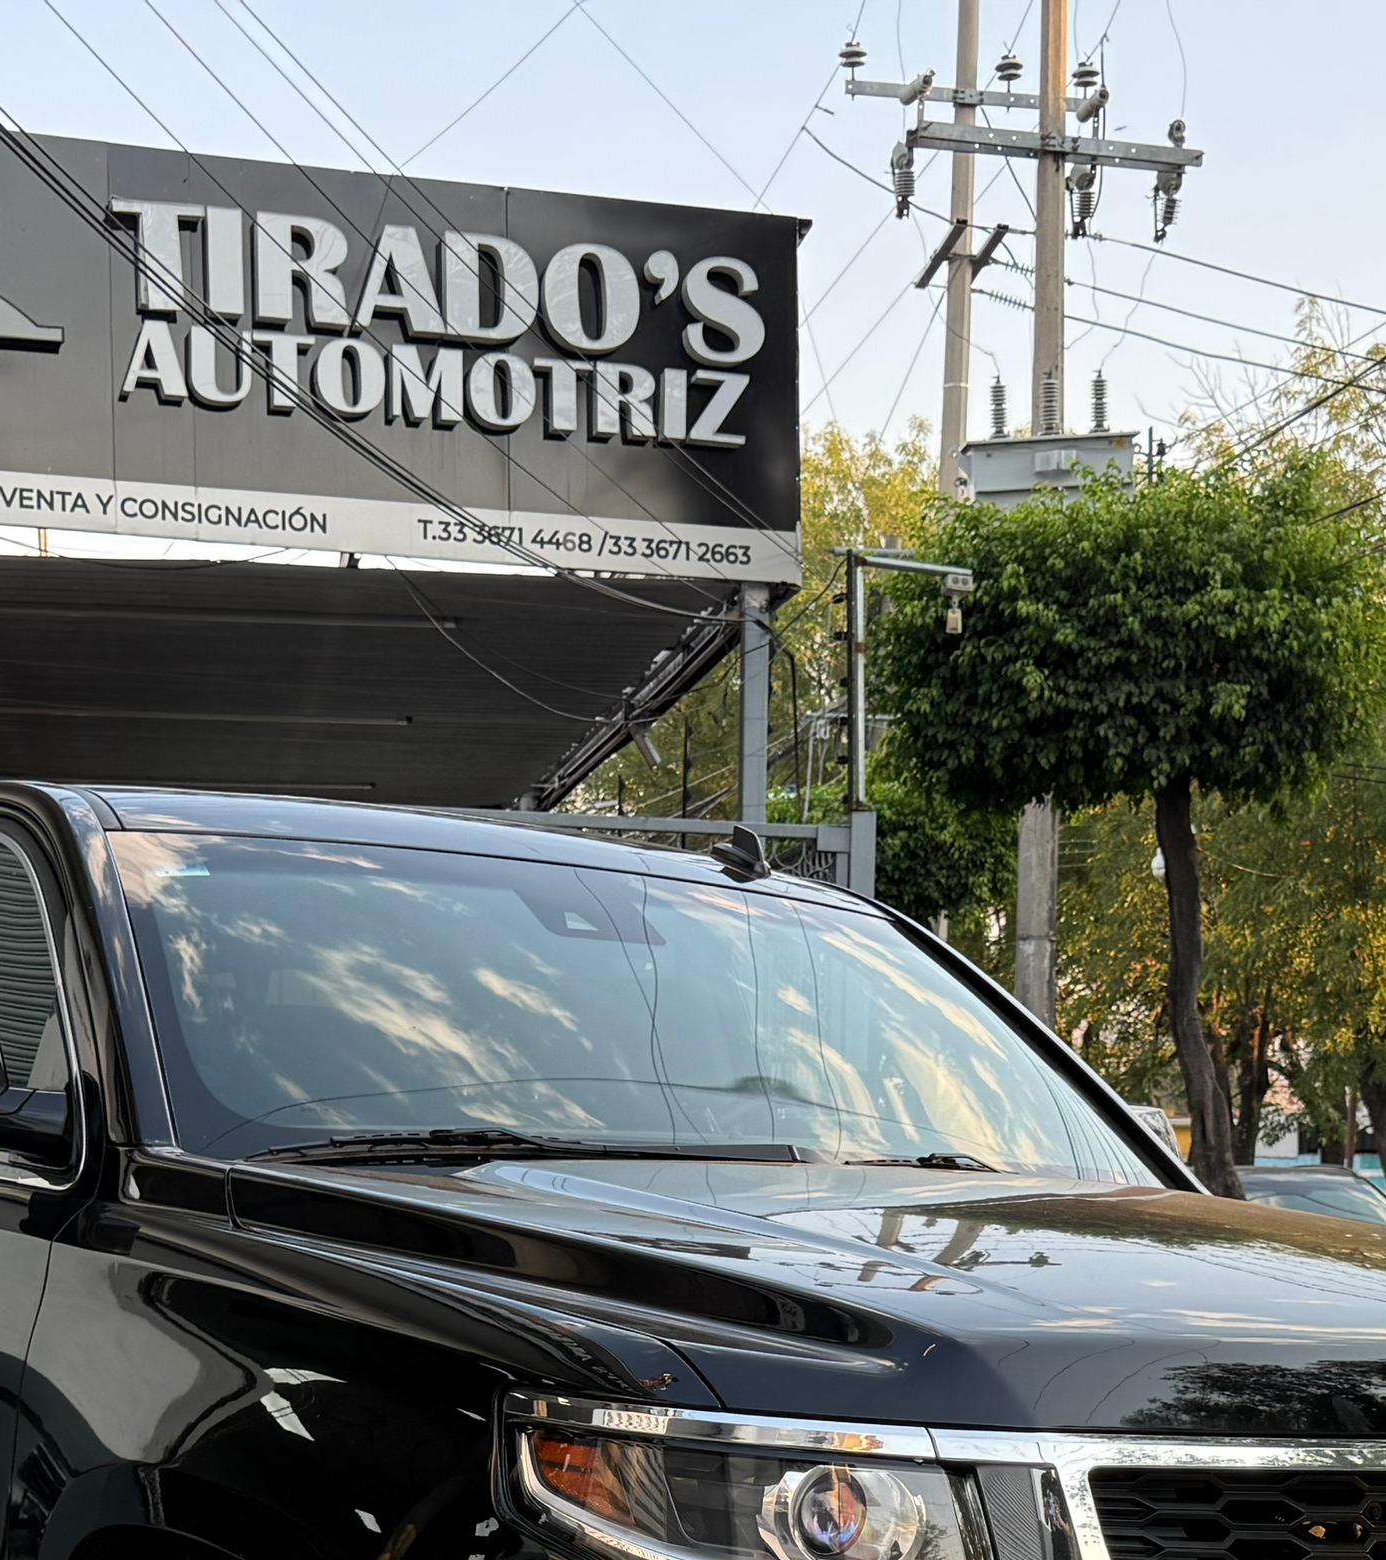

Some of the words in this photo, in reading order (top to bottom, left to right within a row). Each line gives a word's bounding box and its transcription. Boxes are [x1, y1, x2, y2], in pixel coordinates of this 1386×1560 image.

[119, 320, 750, 448] AUTOMOTRIZ
[96, 493, 115, 516] Y
[120, 496, 329, 534] CONSIGNACIÓN
[472, 523, 524, 546] 3671
[531, 528, 593, 553] 4468
[641, 541, 692, 563] 3671
[697, 543, 752, 565] 2663
